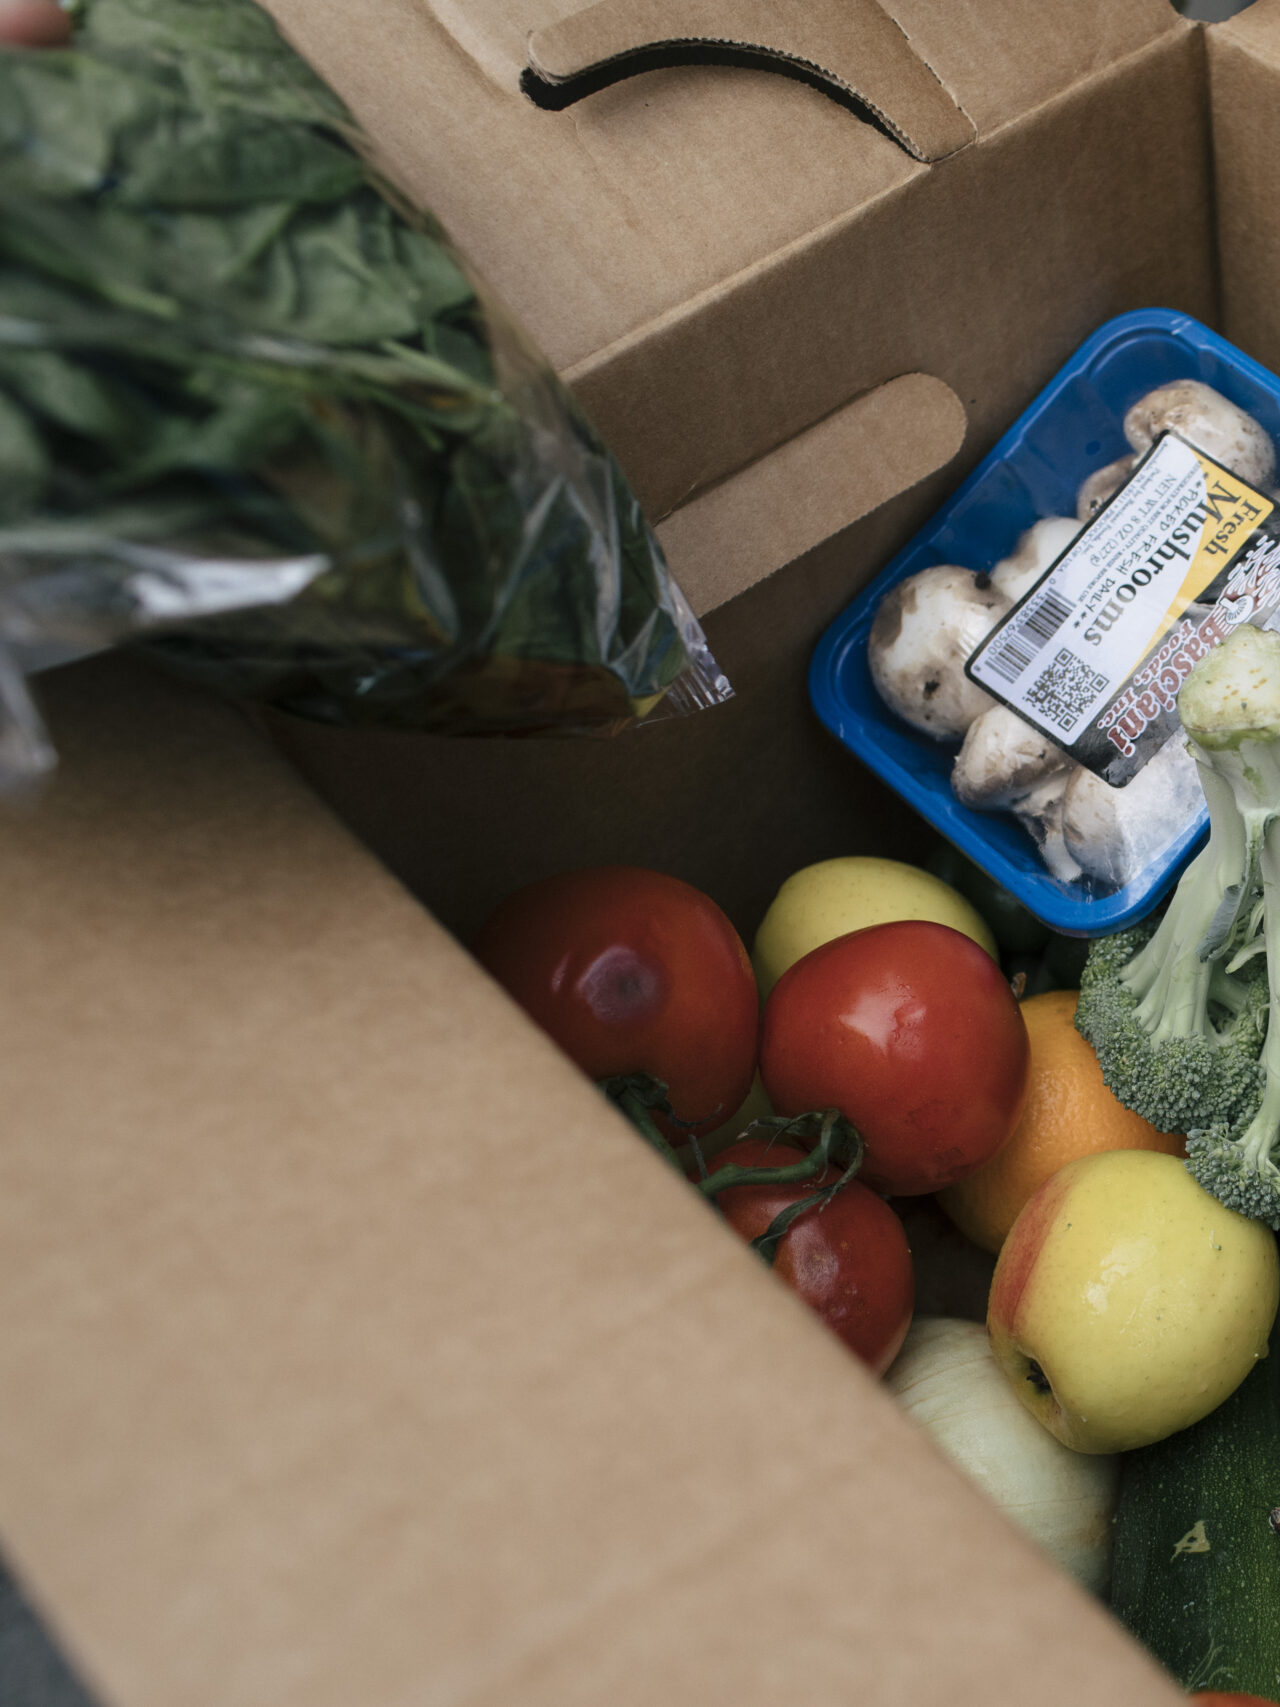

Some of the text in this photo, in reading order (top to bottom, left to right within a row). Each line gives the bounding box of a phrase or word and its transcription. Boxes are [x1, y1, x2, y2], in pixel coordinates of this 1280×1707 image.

[1139, 467, 1160, 491] Packed
[1089, 473, 1176, 568] NET WT 8 OZ (227g)
[1160, 498, 1171, 510] FOR
[1081, 508, 1114, 545] PRODUCT
[1124, 523, 1149, 549] QUALITY
[1203, 498, 1261, 552] Fresh
[1057, 557, 1072, 573] USA
[1070, 545, 1082, 558] OF
[1083, 481, 1241, 646] Mushrooms
[1084, 487, 1199, 612] PICKED FRESH DAILY
[1047, 576, 1056, 585] 0
[1097, 618, 1195, 729] Foods, Inc.
[1107, 615, 1225, 757] Basciani
